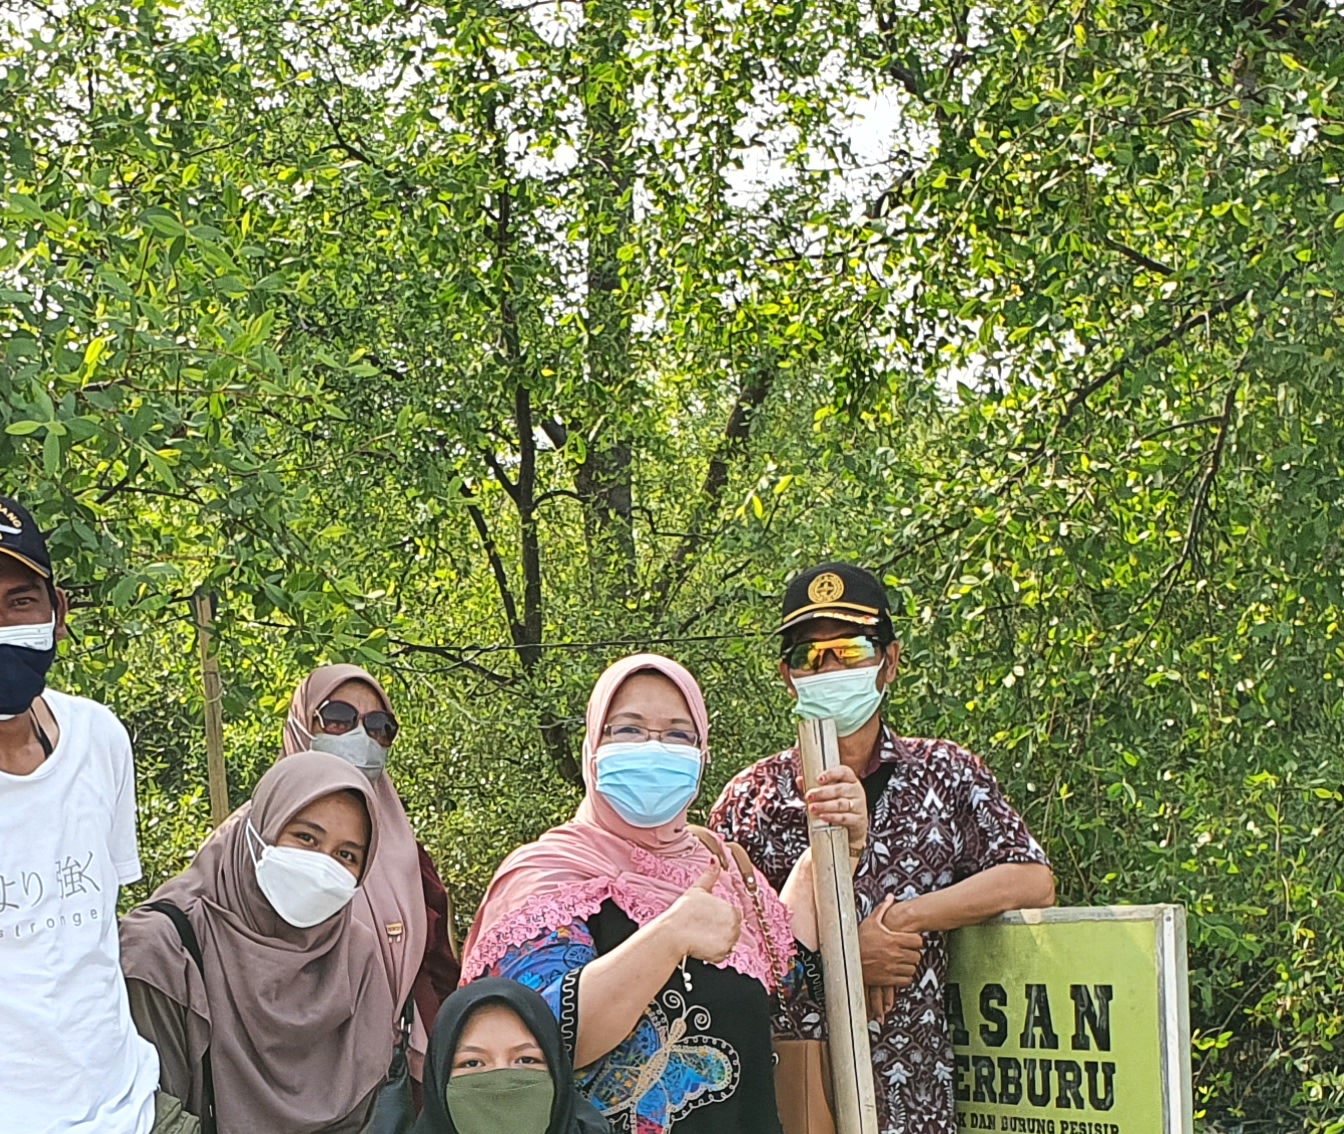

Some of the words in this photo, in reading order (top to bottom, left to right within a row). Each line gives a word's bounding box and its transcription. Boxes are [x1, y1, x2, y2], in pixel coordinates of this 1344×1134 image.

[944, 983, 1113, 1051] ASAN
[955, 1055, 1116, 1112] ERBURU
[970, 1113, 996, 1130] DAN
[1001, 1116, 1055, 1134] BURUNG
